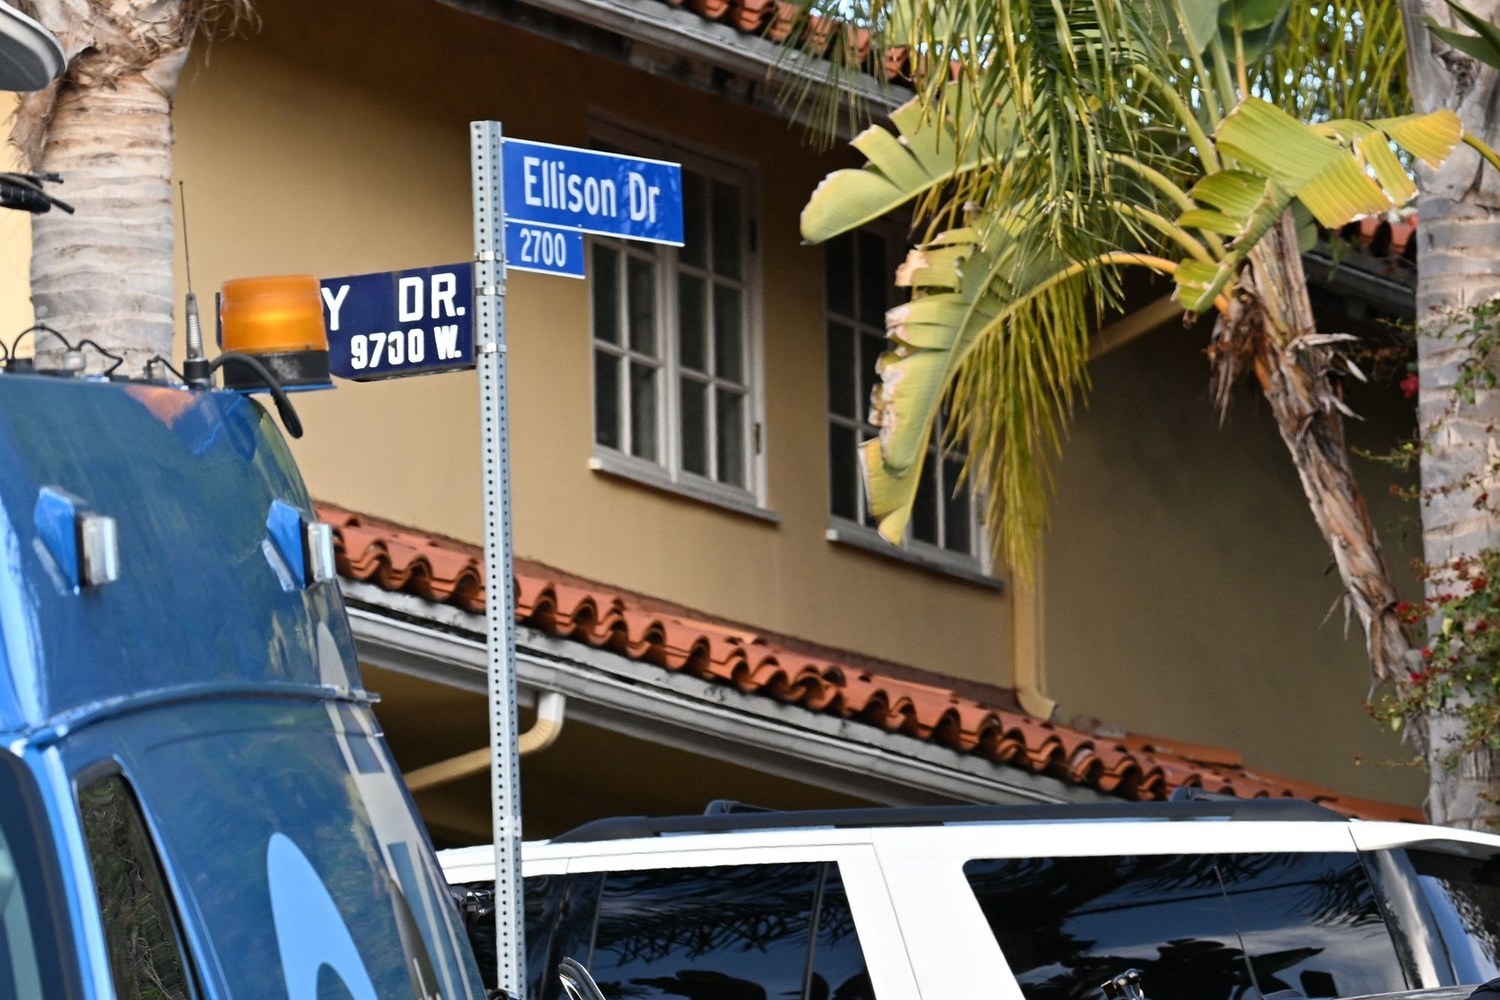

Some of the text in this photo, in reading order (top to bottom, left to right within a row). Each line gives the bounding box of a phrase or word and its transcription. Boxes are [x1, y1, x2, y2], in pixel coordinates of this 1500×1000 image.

[523, 156, 661, 224] Ellison Dr
[520, 228, 567, 267] 2700
[399, 273, 466, 322] DR.
[433, 324, 462, 360] W.
